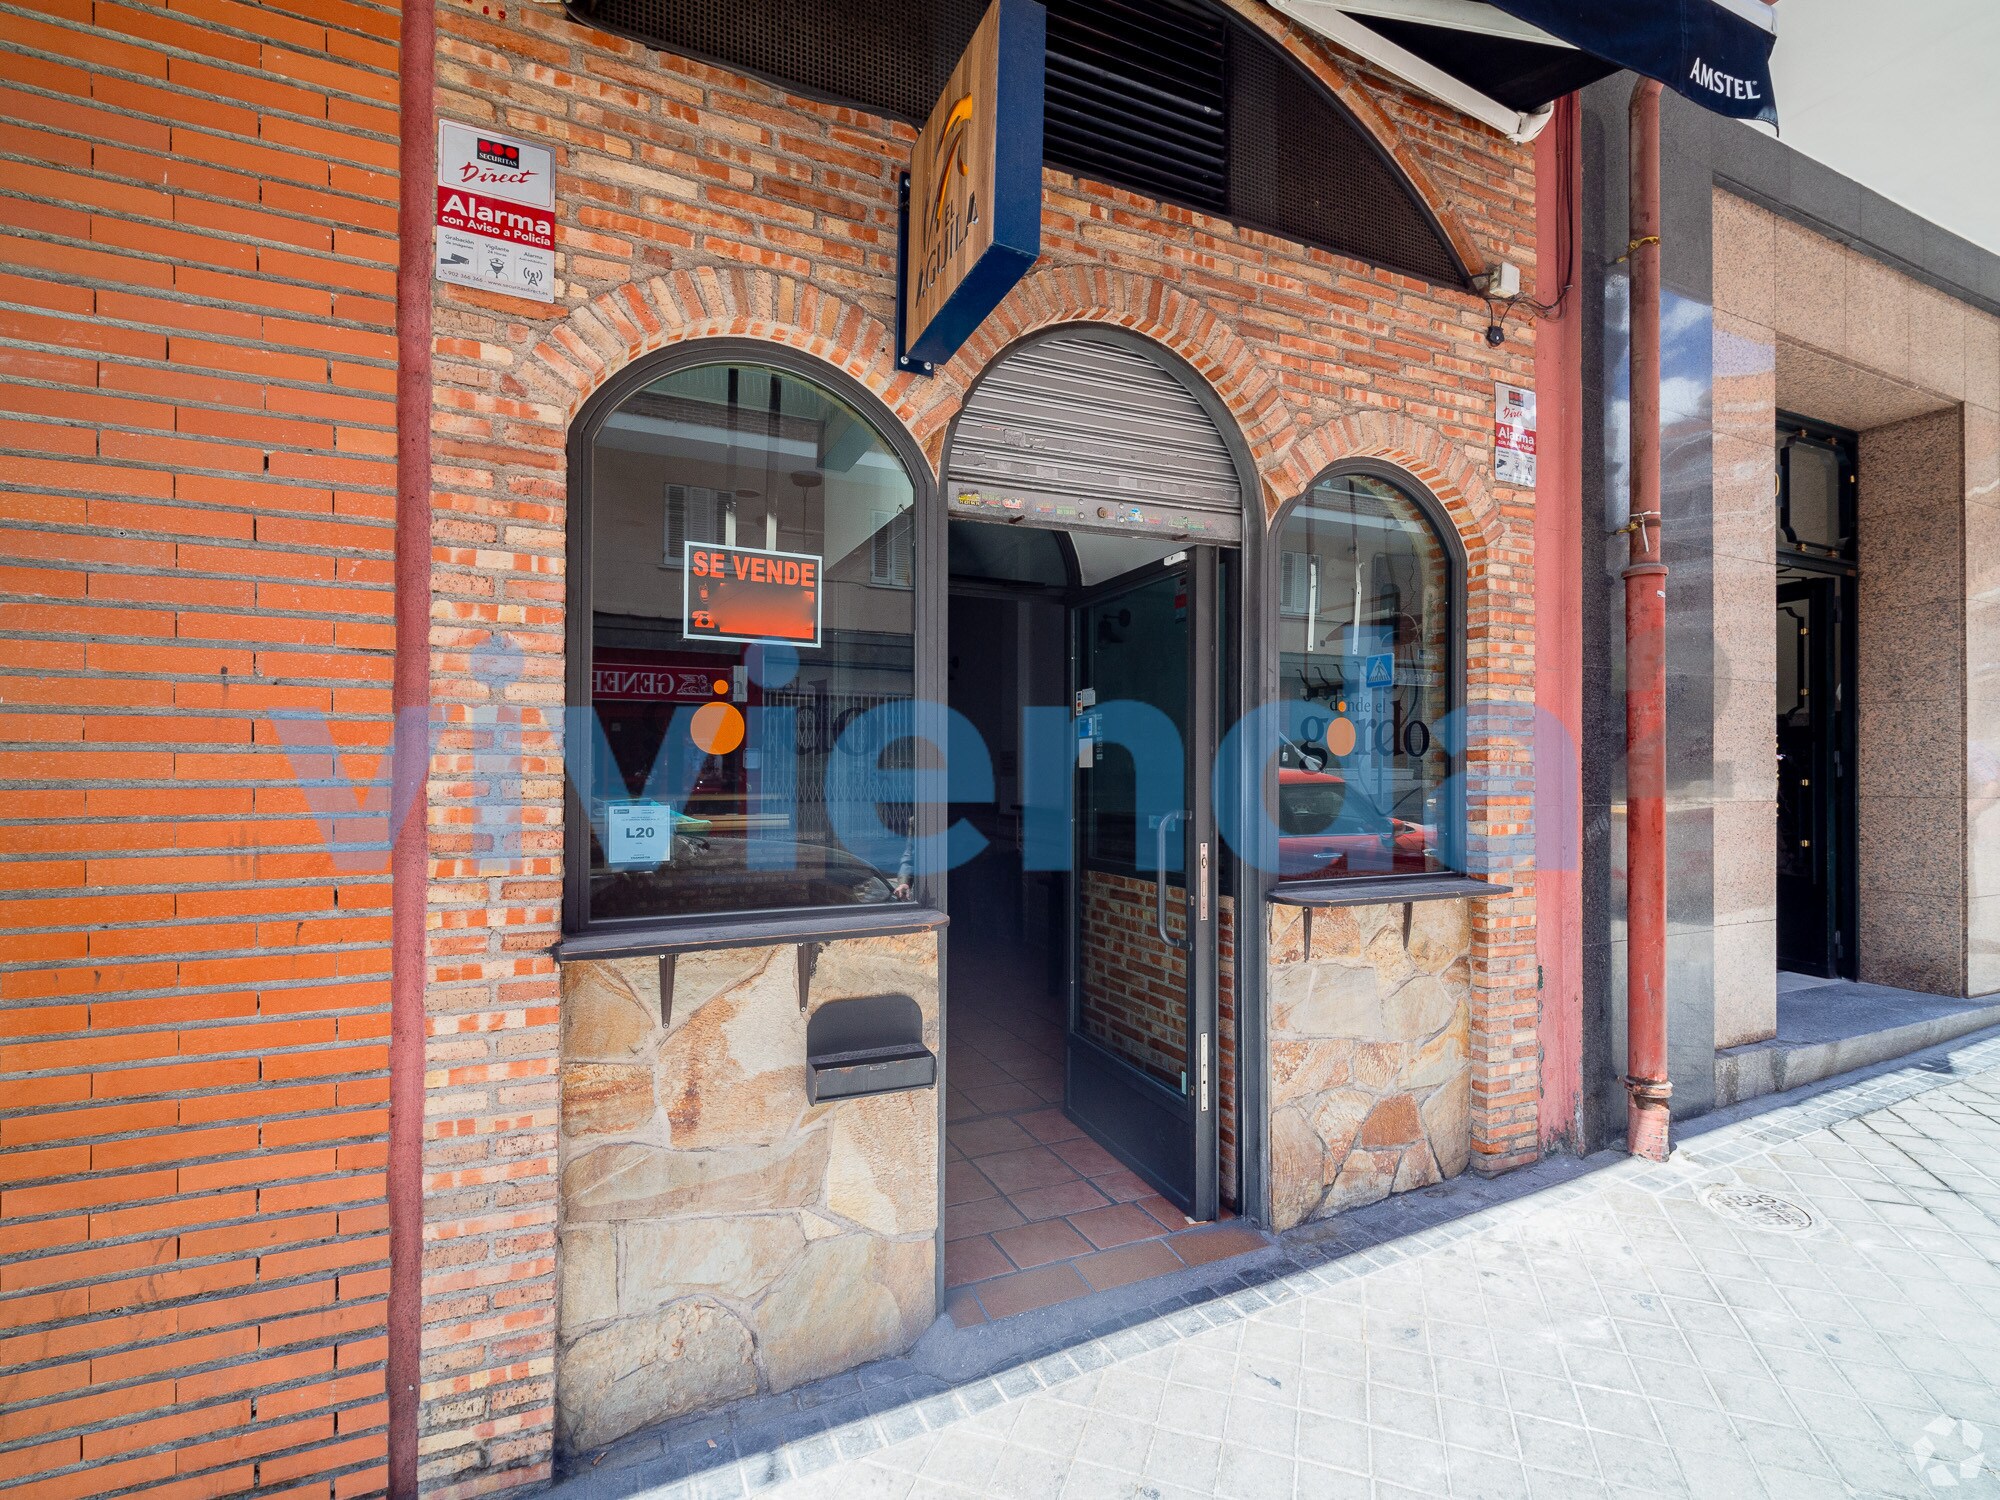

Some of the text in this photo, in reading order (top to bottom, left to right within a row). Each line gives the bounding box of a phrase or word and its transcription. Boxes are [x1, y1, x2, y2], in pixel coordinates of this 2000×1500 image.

[1689, 57, 1761, 100] AMSTEL
[478, 152, 518, 167] SECURITAS
[459, 162, 539, 184] Direct
[442, 194, 551, 236] Alarma
[441, 214, 551, 246] con Aviso a Policía
[444, 234, 475, 245] Grabación
[484, 243, 510, 253] Vigilante
[523, 252, 543, 260] Alarma
[1498, 426, 1535, 444] Alarma
[692, 551, 815, 588] SE VENDE
[1329, 698, 1387, 714] donde el
[1298, 700, 1430, 775] gordo
[625, 827, 655, 839] L20
